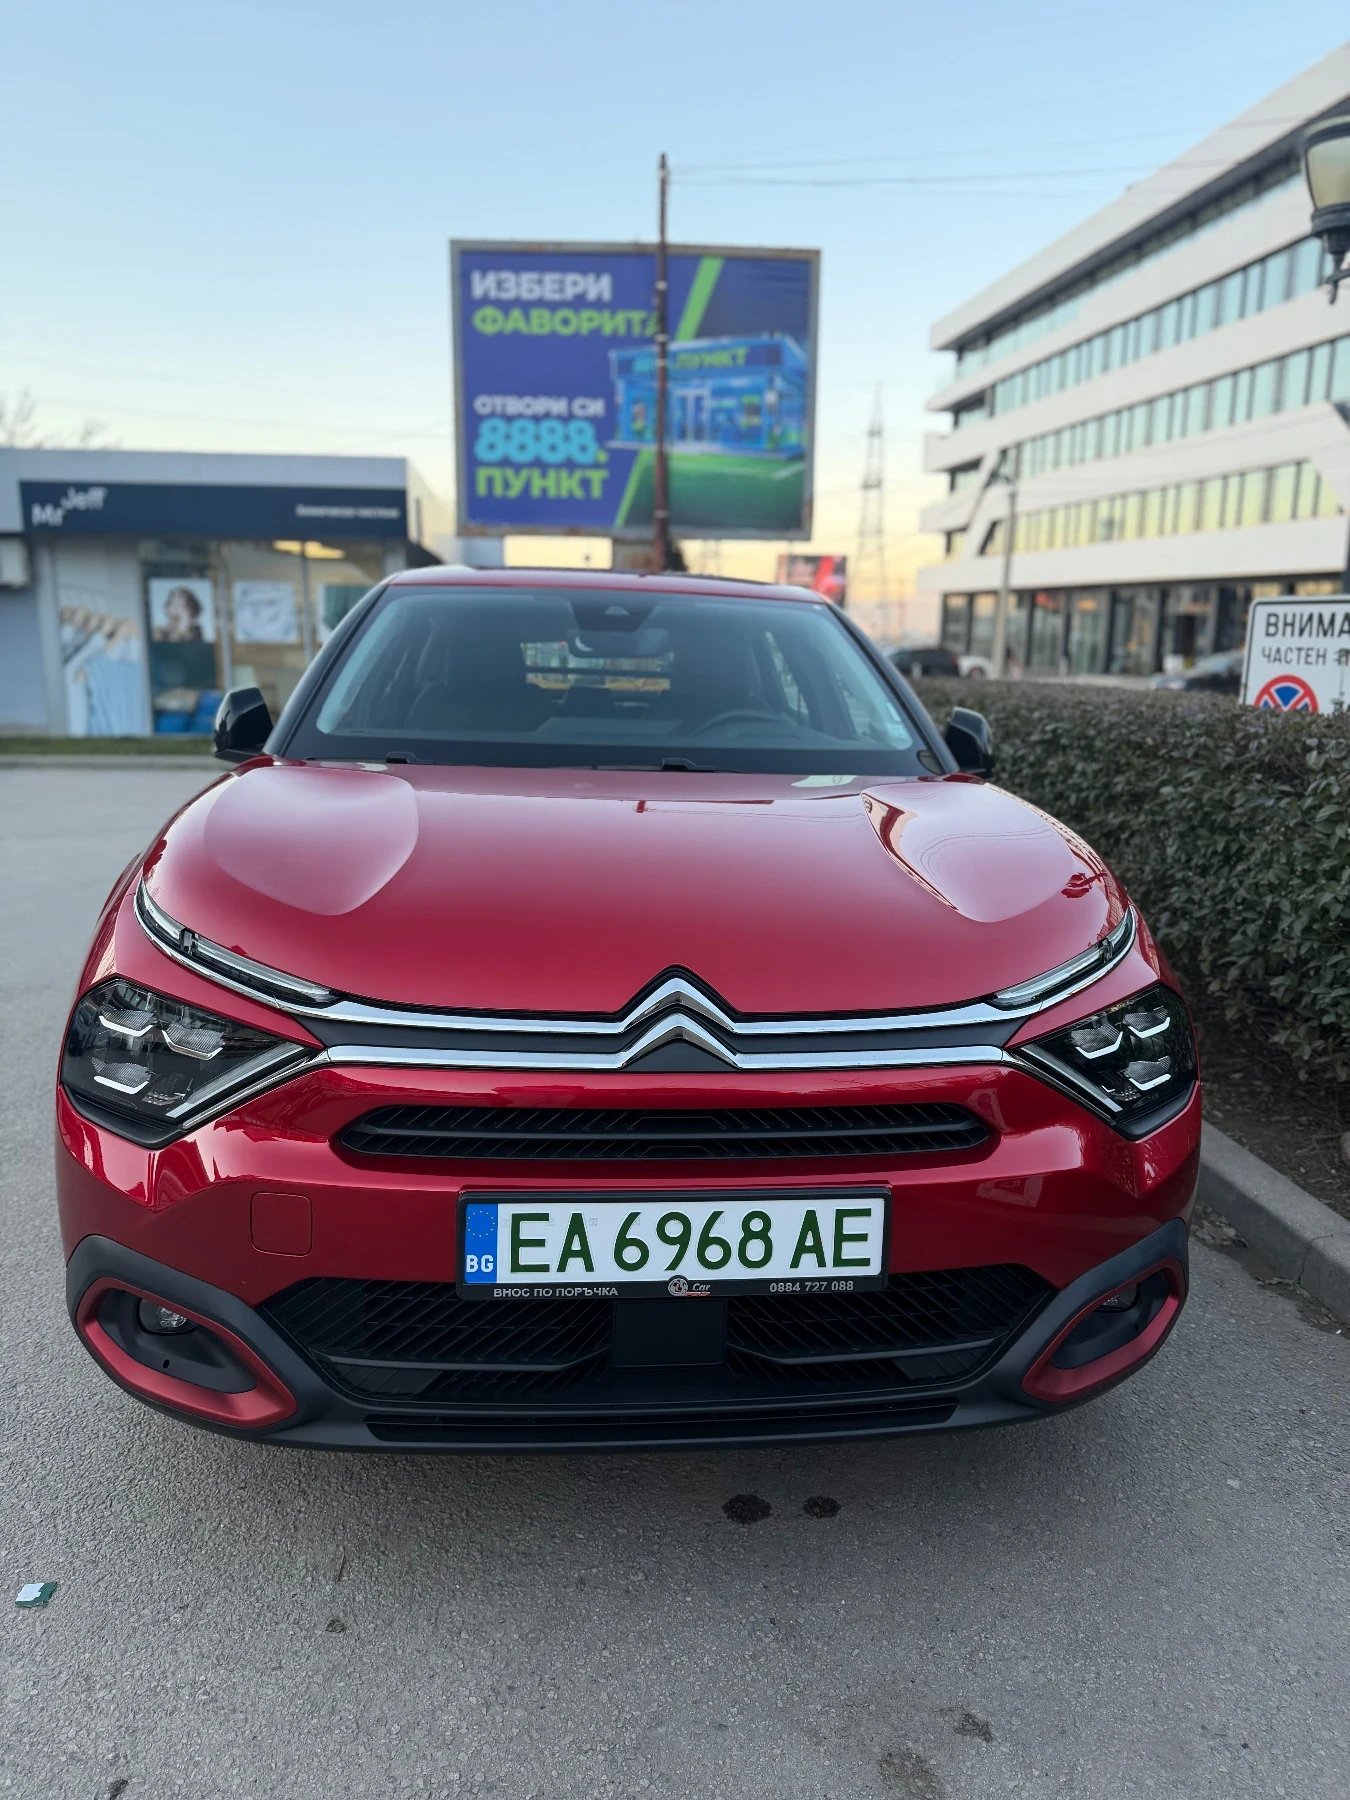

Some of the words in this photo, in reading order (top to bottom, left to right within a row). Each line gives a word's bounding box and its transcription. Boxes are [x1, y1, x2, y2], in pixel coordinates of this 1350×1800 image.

[472, 271, 612, 301] ИЗБЕРИ
[474, 395, 568, 416] ОТВОРИ
[572, 398, 605, 417] СИ
[477, 468, 609, 498] ПУНКТ
[31, 502, 63, 527] Mr
[61, 486, 108, 511] Jeff
[1265, 612, 1350, 638] ВНИМА
[1262, 646, 1327, 665] ЧАСТЕН
[510, 1212, 595, 1274] EA
[613, 1210, 774, 1272] 6968
[790, 1207, 872, 1269] AE
[466, 1253, 494, 1274] BG
[493, 1289, 529, 1298] ВНОС
[534, 1288, 552, 1297] ПО
[556, 1287, 618, 1297] ПОРЪЧКА
[692, 1282, 711, 1292] Car
[769, 1282, 801, 1293] 0884
[804, 1281, 828, 1292] 727
[831, 1280, 855, 1291] 088
